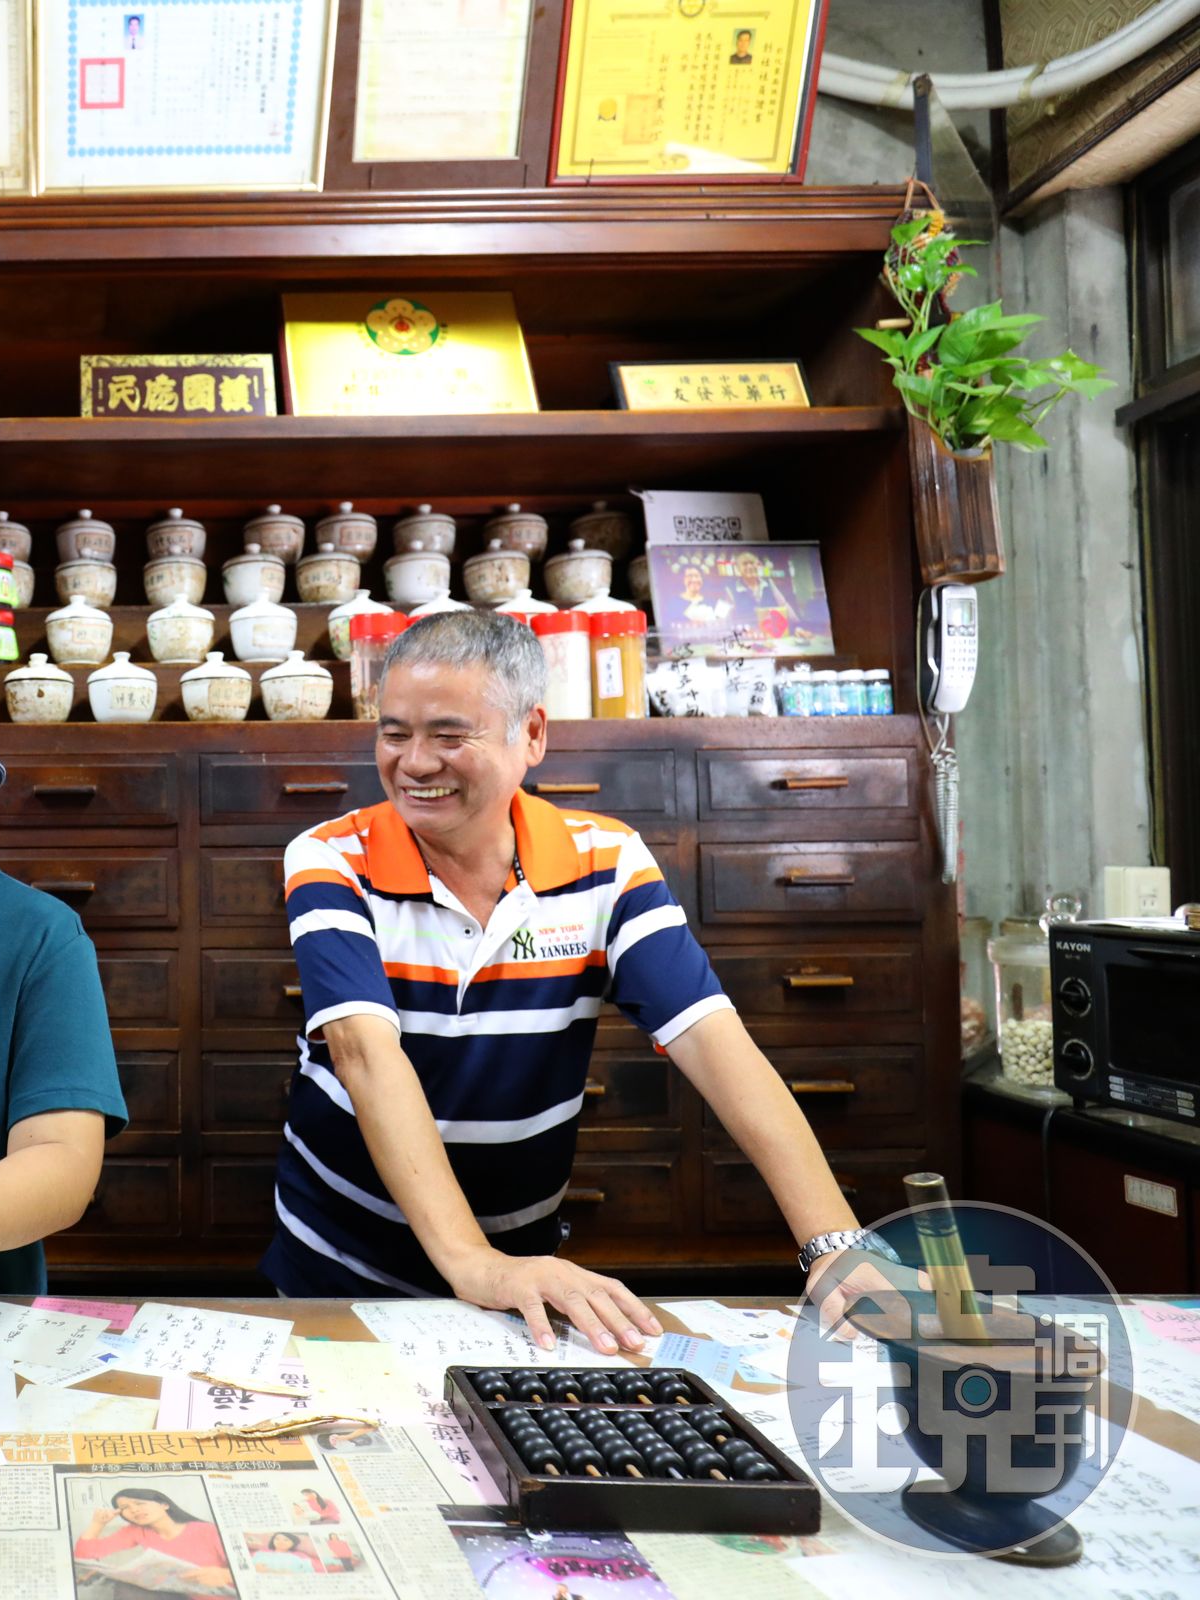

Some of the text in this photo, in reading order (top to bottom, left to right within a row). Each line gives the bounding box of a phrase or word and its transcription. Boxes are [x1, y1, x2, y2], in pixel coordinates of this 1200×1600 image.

[538, 923, 585, 936] NEW YORK
[540, 941, 588, 958] YANKEES
[1055, 940, 1091, 953] KAYON
